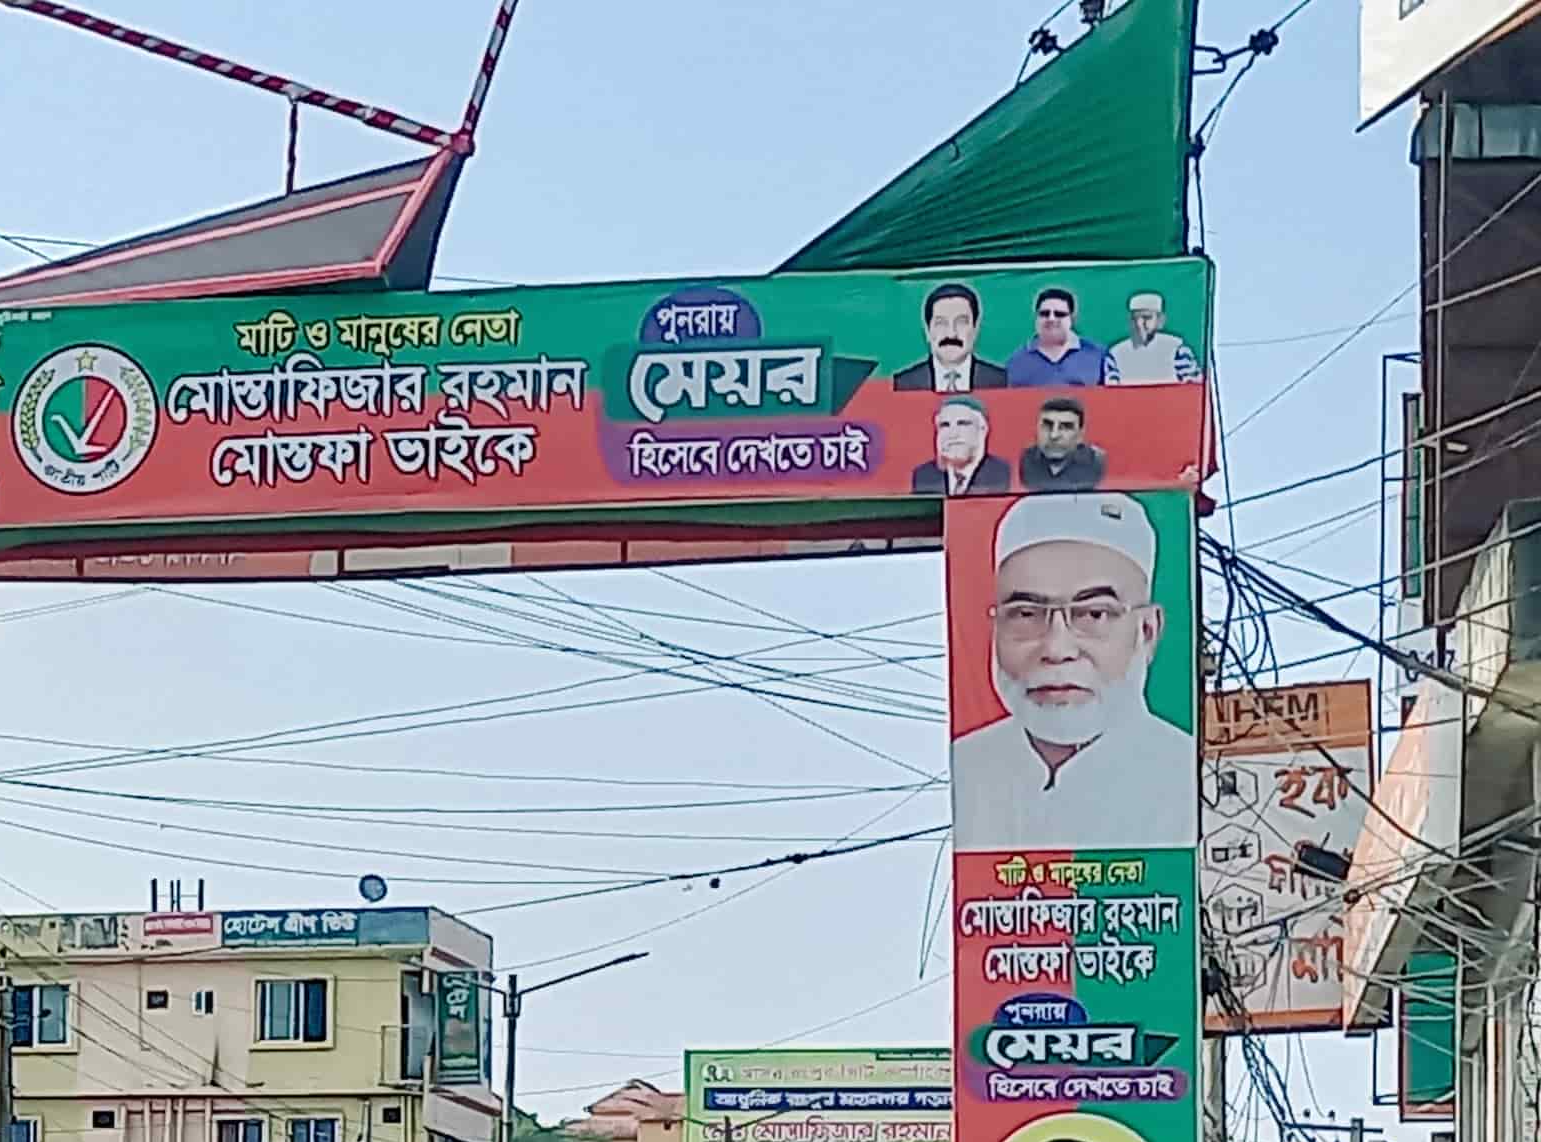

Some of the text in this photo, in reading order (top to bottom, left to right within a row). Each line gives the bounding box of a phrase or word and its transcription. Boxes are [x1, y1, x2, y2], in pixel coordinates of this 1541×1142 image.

[236, 309, 520, 359] মাটি ও মানুষের নেতা
[656, 301, 738, 343] পুনরায়
[166, 354, 588, 424] মোস্তাফিজার রহমান
[628, 343, 822, 423] মেয়র
[212, 409, 535, 487] মোস্তফা ভাইকে
[628, 425, 870, 479] হিসেবে দেখতে চাই
[1107, 860, 1145, 884] নেতা
[960, 885, 1180, 938] মোস্তাফিজার রহমান
[985, 932, 1155, 985] মোস্তফা ভাইকে
[985, 1026, 1136, 1070] মেয়র
